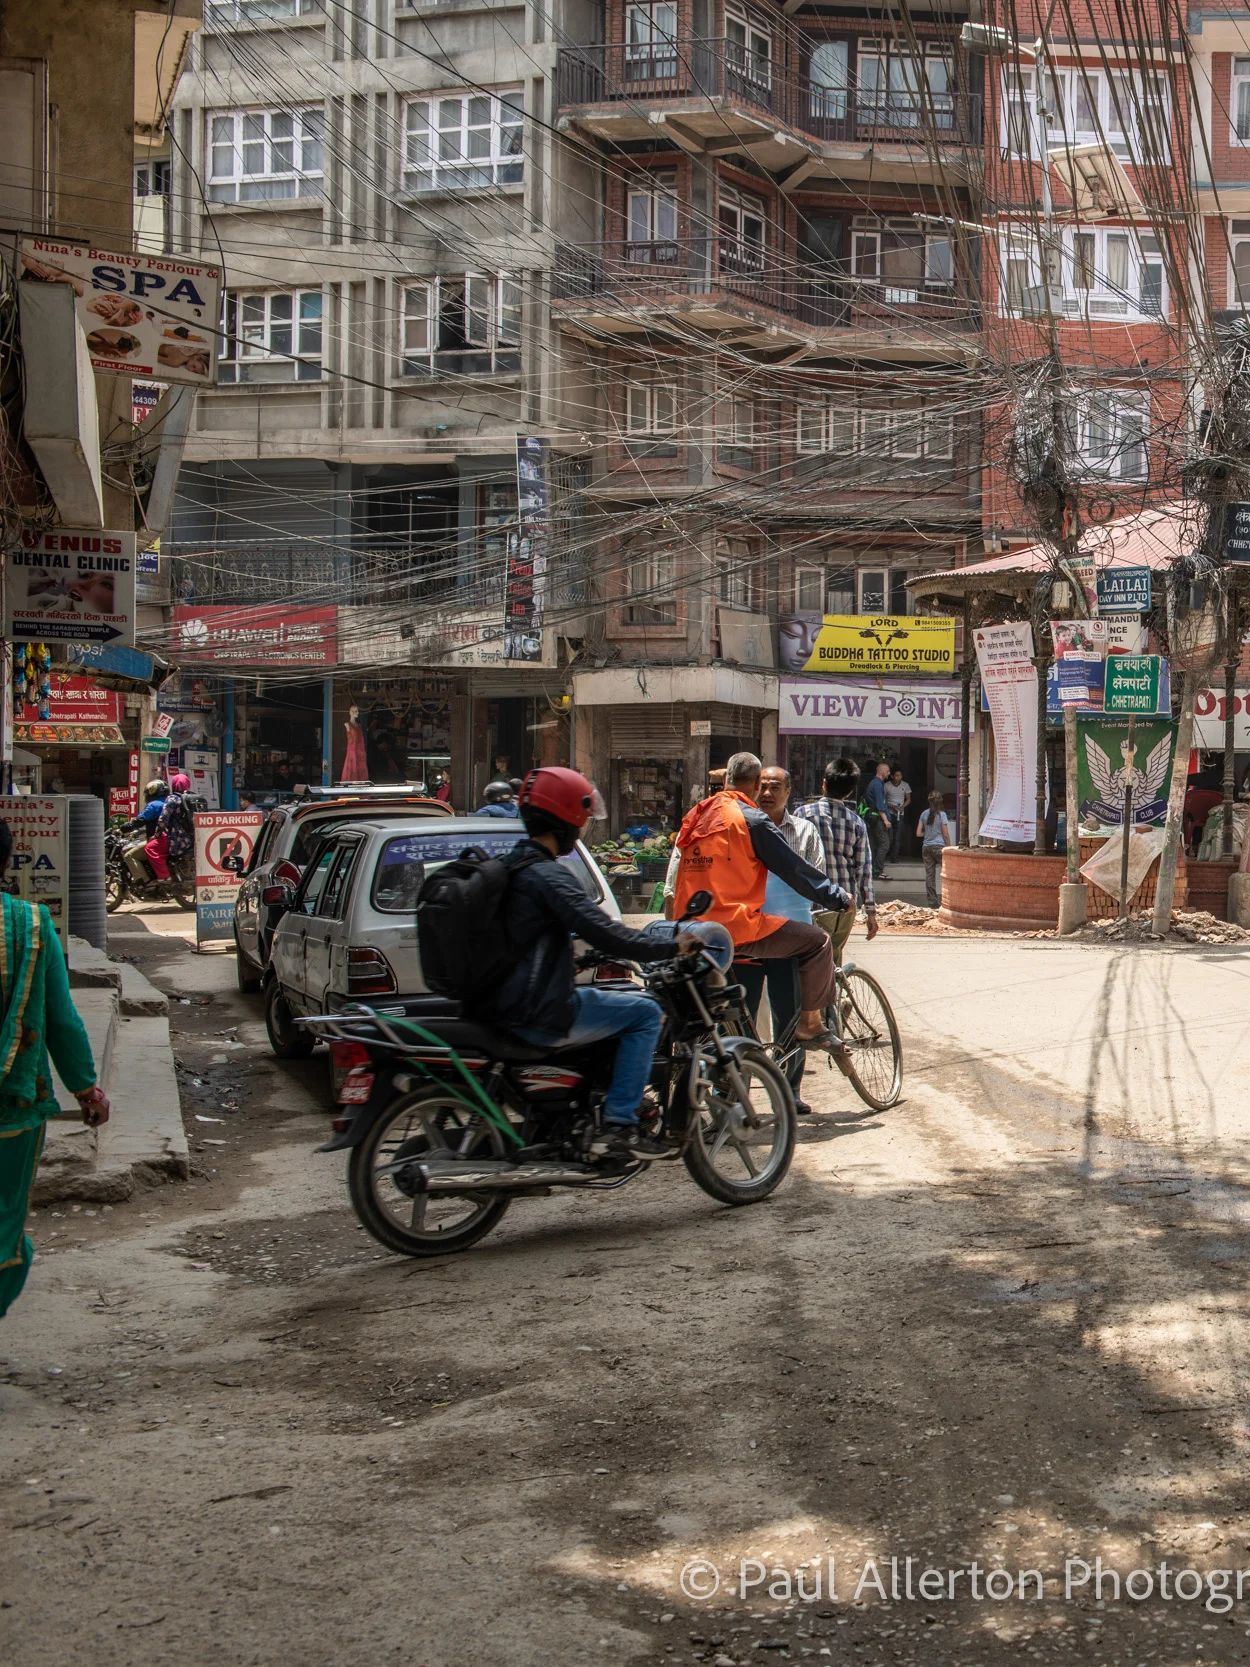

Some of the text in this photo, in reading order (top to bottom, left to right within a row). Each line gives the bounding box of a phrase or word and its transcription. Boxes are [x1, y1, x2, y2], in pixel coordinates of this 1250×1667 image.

[33, 239, 219, 280] Nina's Beauty Parlour &
[91, 265, 206, 306] SPA
[93, 360, 143, 372] First Floor
[21, 528, 122, 554] VENUS
[12, 551, 130, 571] DENTAL CLINIC
[1114, 593, 1126, 602] INN
[511, 600, 526, 615] Inn
[15, 622, 38, 630] BEHIND
[870, 618, 899, 628] LORD
[213, 628, 278, 643] HUAWEI
[300, 652, 325, 660] CENTER
[819, 647, 950, 662] BUDDHA TATTOO STUDIO
[893, 663, 919, 672] Piercing
[1112, 675, 1151, 690] क्षेत्रपाटी
[789, 694, 962, 720] VIEW POINT
[1111, 695, 1151, 709] CHHETRAPATI
[47, 713, 77, 721] Chhetrapati
[130, 754, 139, 822] GUPT
[1091, 803, 1154, 820] CHHETRAPATI CLUB
[6, 814, 59, 825] eauty
[198, 815, 258, 825] NO PARKING
[12, 829, 61, 838] rlour
[16, 842, 33, 851] &
[388, 841, 444, 854] संसार
[9, 854, 56, 871] PA
[200, 907, 236, 919] FAIRF
